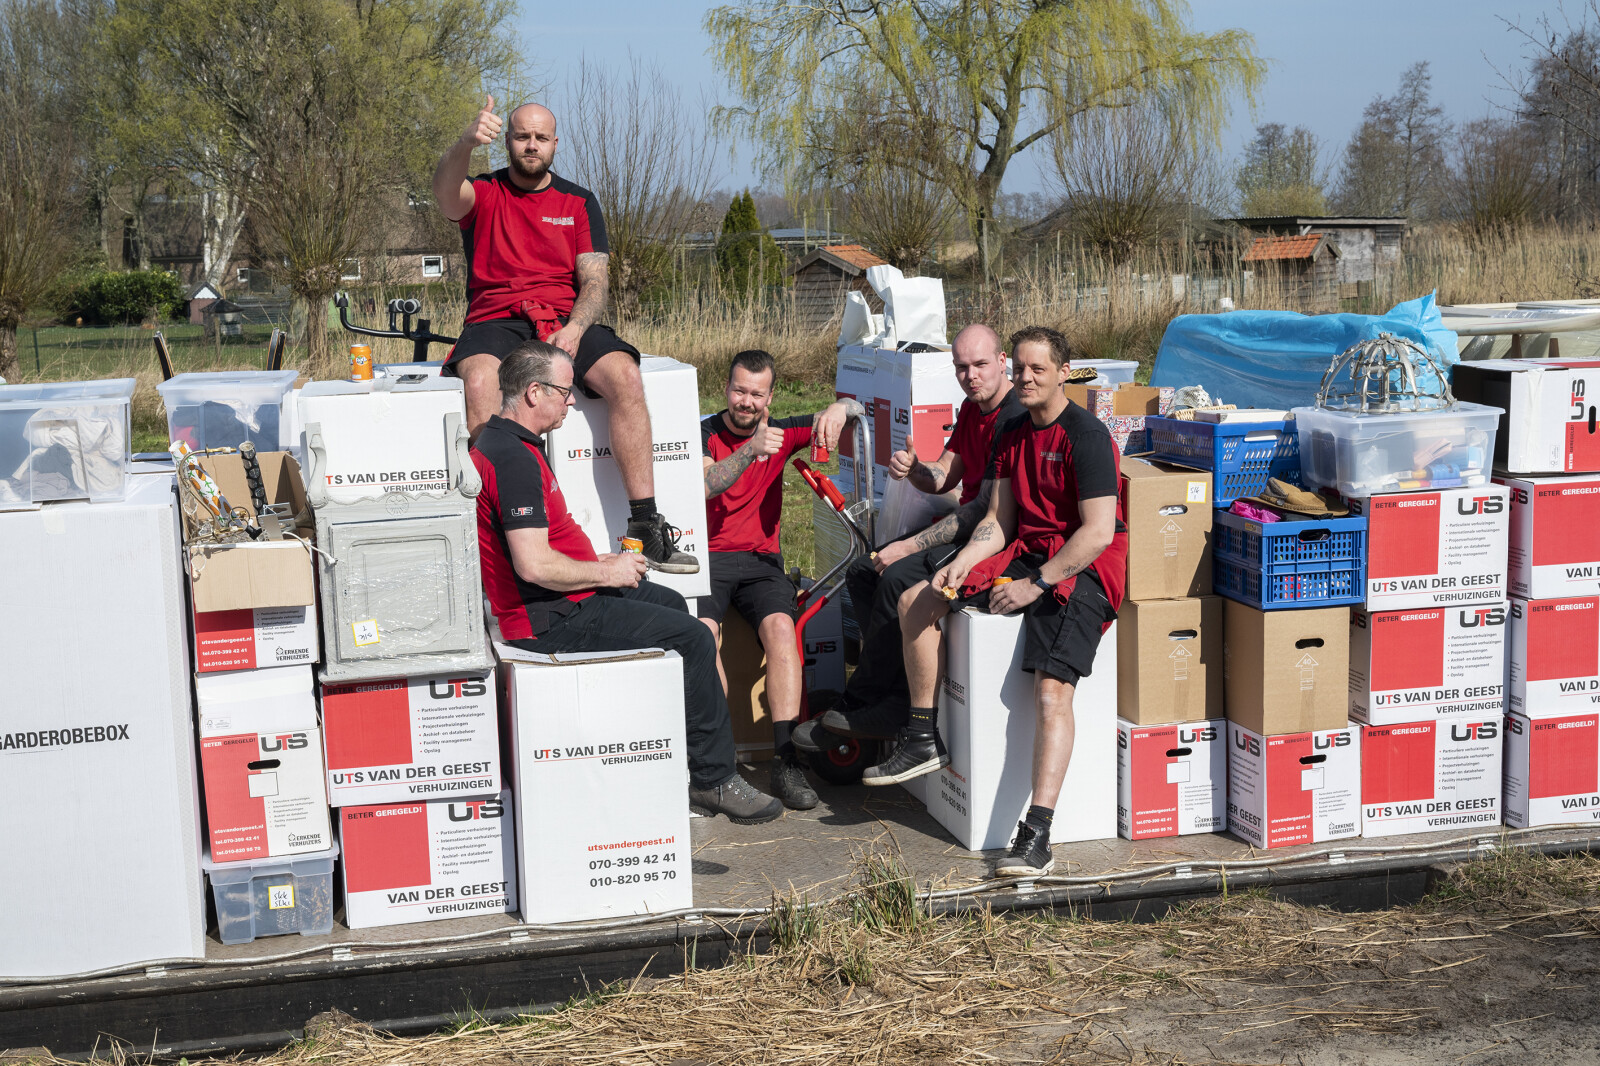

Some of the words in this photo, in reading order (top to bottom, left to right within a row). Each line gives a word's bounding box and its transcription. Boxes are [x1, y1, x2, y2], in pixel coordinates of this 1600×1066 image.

[1571, 379, 1585, 420] UTS
[895, 408, 908, 425] UTS
[568, 449, 591, 458] UTS
[595, 448, 611, 456] VA
[653, 442, 688, 452] GEEST
[326, 475, 342, 484] TS
[348, 473, 375, 483] VAN
[380, 472, 405, 482] DER
[511, 507, 533, 516] UTS
[1458, 496, 1503, 515] UTS
[684, 544, 695, 552] 41
[1566, 567, 1592, 578] VAN
[1373, 582, 1397, 592] UTS
[1402, 580, 1427, 590] VAN
[1432, 578, 1456, 588] DER
[1462, 574, 1501, 585] GEEST
[1433, 590, 1501, 601] VERHUIZINGEN
[1556, 603, 1593, 611] GEREGELD!
[1401, 613, 1439, 621] GEREGELD!
[1460, 608, 1505, 627] UTS
[806, 641, 836, 655] UTS
[356, 684, 403, 692] GEREGELD!
[430, 677, 486, 699] UTS
[1560, 681, 1585, 692] VAN
[1376, 694, 1400, 705] UTS
[1405, 692, 1430, 702] VAN
[1435, 690, 1459, 700] DER
[1464, 685, 1503, 697] GEEST
[1436, 701, 1503, 713] VERHUIZINGEN
[1392, 727, 1430, 735] GEREGELD!
[1452, 722, 1497, 741] UTS
[1558, 721, 1594, 729] GEREGELD!
[261, 733, 308, 752] UTS
[1180, 727, 1217, 743] UTS
[1315, 732, 1350, 749] UTS
[534, 749, 561, 759] UTS
[565, 746, 594, 757] VAN
[599, 743, 625, 754] DER
[629, 739, 671, 751] GEEST
[1236, 730, 1260, 757] UTS
[602, 752, 672, 765] VERHUIZINGEN
[333, 772, 363, 784] UTS
[368, 769, 400, 781] VAN
[406, 767, 436, 778] DER
[442, 762, 491, 775] GEEST
[409, 779, 492, 793] VERHUIZINGEN
[1367, 807, 1392, 818] UTS
[1396, 805, 1422, 815] VAN
[1427, 802, 1451, 812] DER
[1456, 798, 1495, 810] GEEST
[1562, 798, 1586, 808] VAN
[376, 807, 422, 817] GEREGELD!
[448, 800, 504, 822] UTS
[1240, 808, 1261, 827] GEEST
[1428, 814, 1495, 826] VERHUIZINGEN
[289, 839, 321, 847] VERHUIZERS
[588, 836, 674, 851] utsvandergeest.nl
[589, 857, 639, 869] 070-399
[644, 855, 658, 864] 42
[663, 853, 676, 862] 41
[590, 874, 640, 887] 010-820
[644, 872, 658, 882] 95
[662, 870, 676, 880] 70
[388, 891, 419, 903] VAN
[425, 888, 454, 900] DER
[461, 882, 508, 896] GEEST
[428, 898, 509, 914] VERHUIZINGEN
